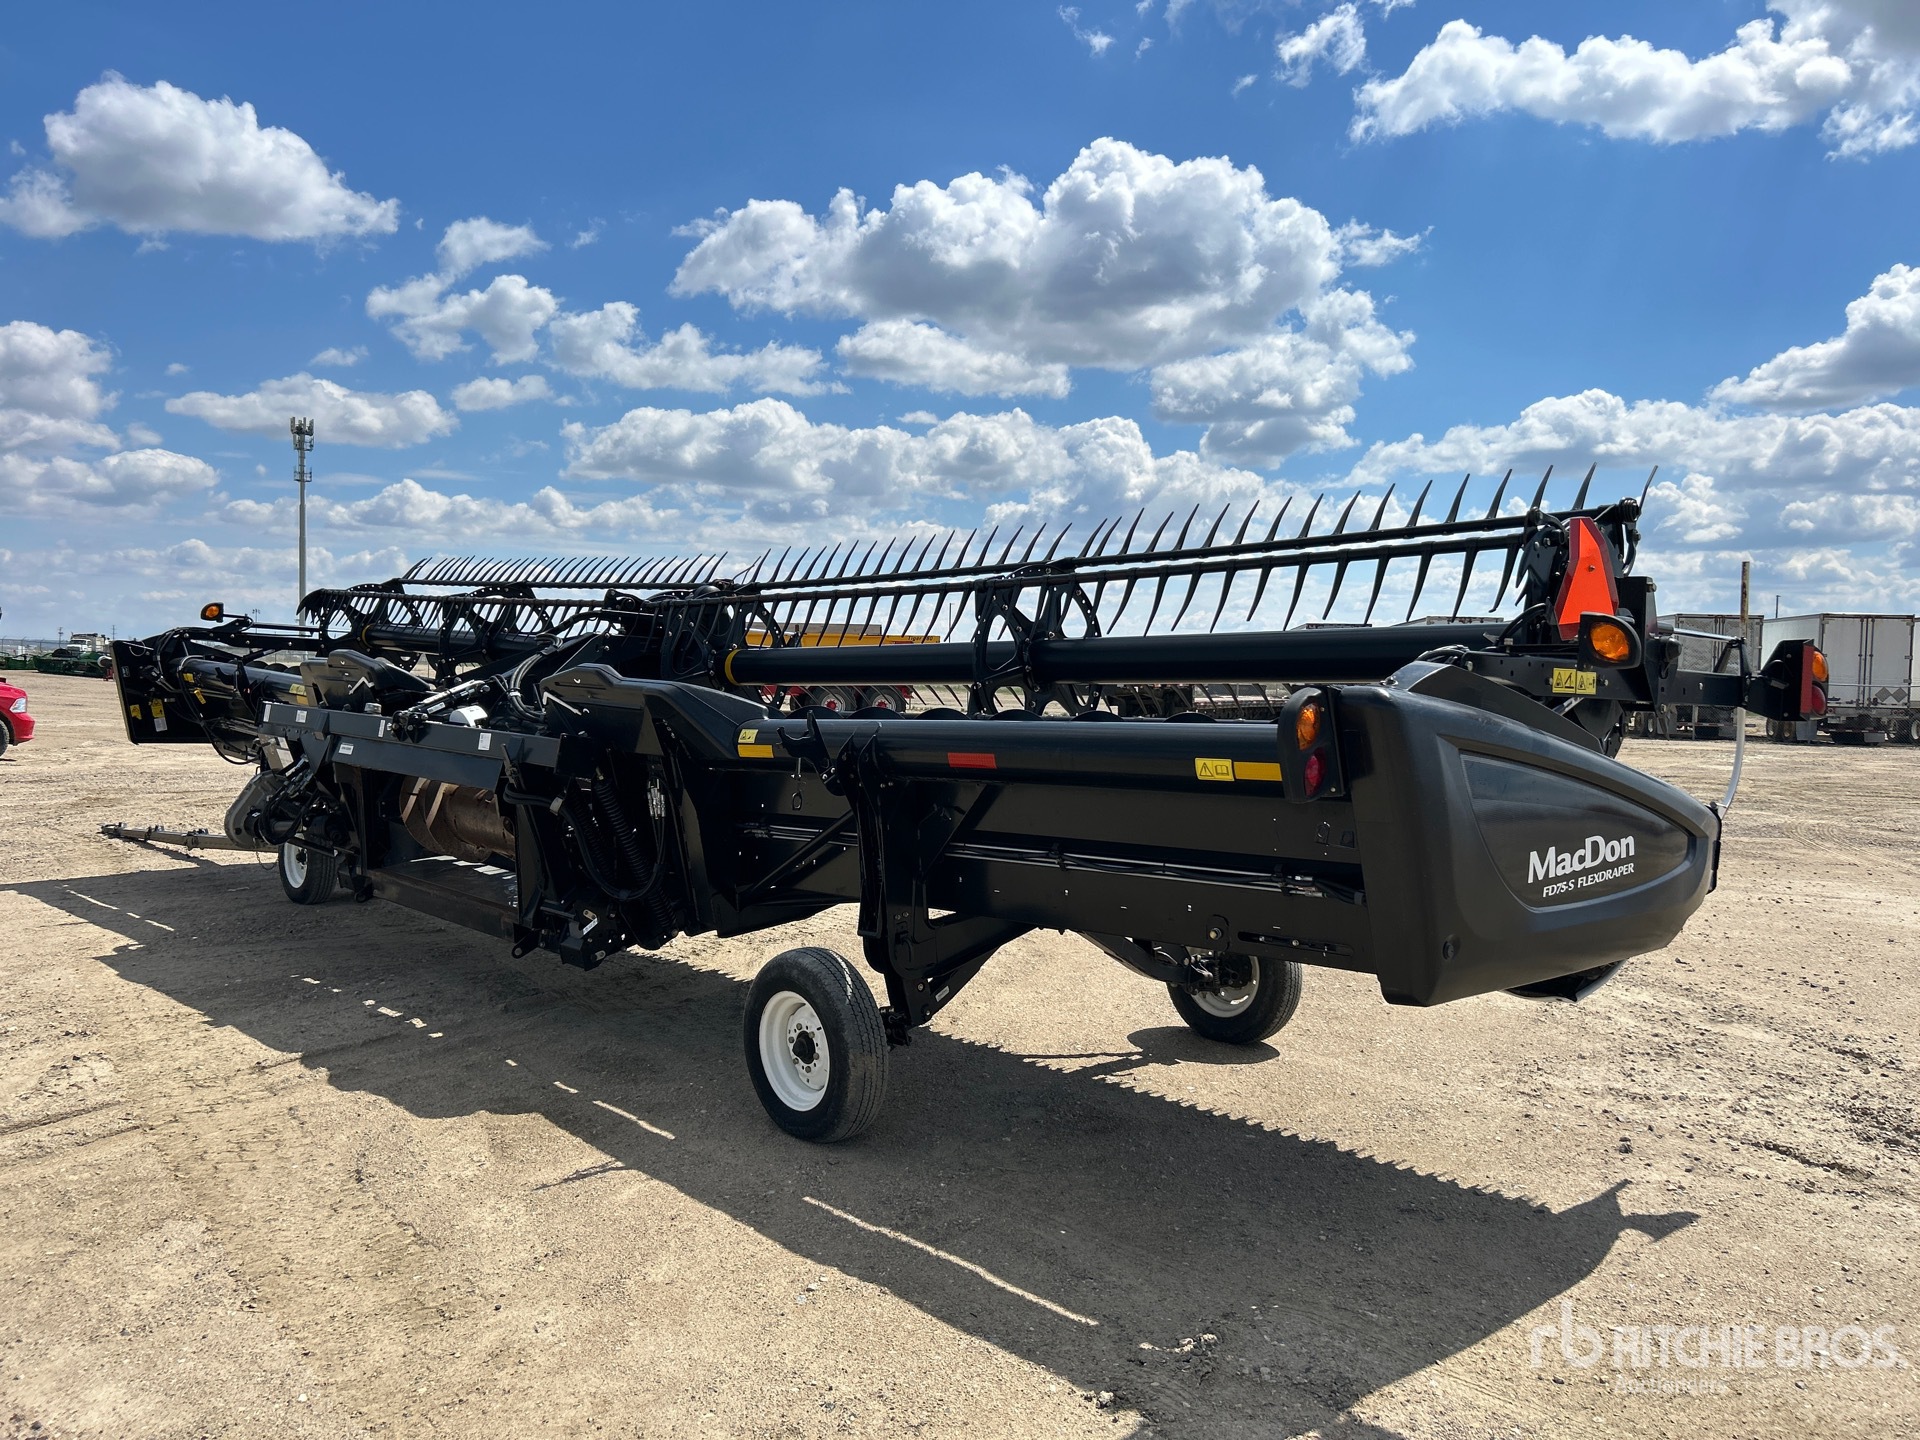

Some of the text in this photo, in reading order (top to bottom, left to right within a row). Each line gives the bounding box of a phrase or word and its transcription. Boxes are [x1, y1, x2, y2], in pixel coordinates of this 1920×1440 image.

[1528, 835, 1635, 883] MacDon
[1542, 863, 1635, 898] FD75-S FLEXDRAPER
